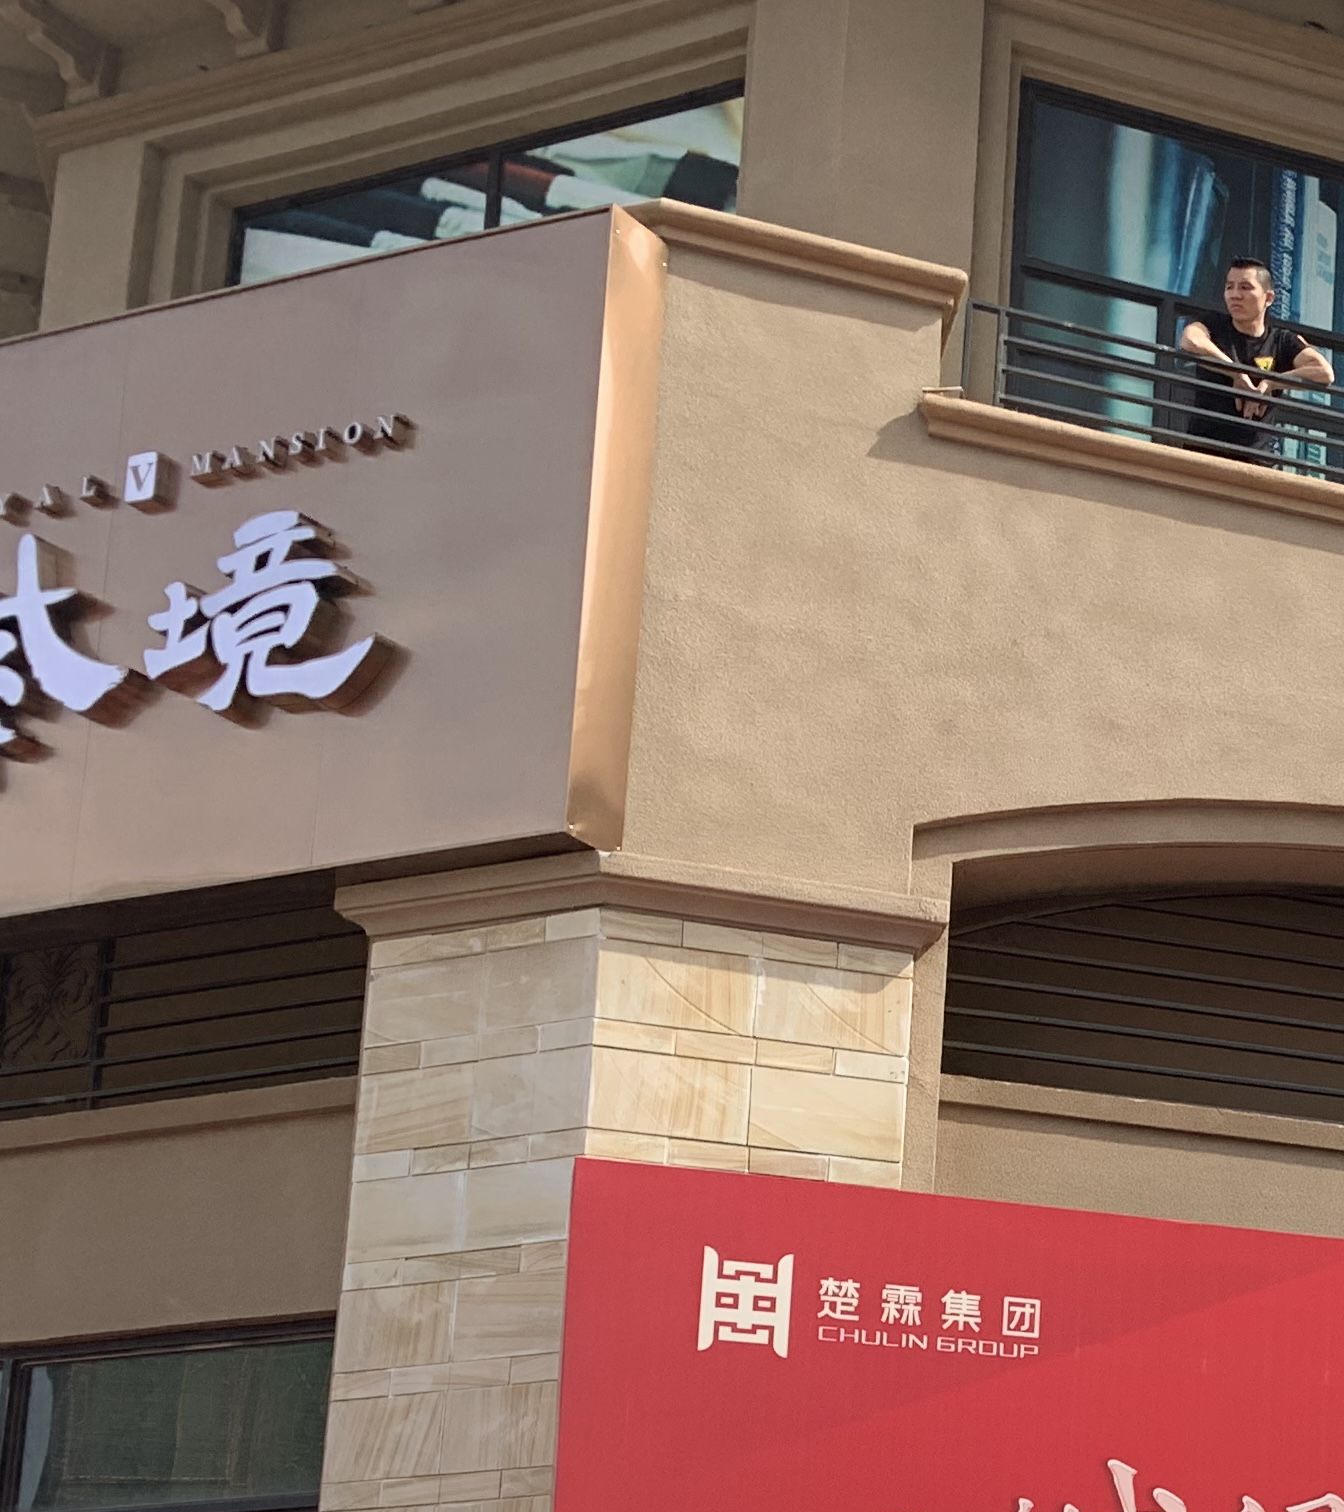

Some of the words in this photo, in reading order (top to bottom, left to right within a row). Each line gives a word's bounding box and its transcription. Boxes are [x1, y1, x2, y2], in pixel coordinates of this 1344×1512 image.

[190, 414, 396, 476] MANSION
[817, 1276, 1042, 1339] 楚霖集团
[817, 1325, 929, 1351] CHULIN
[936, 1336, 1040, 1359] GROUP
